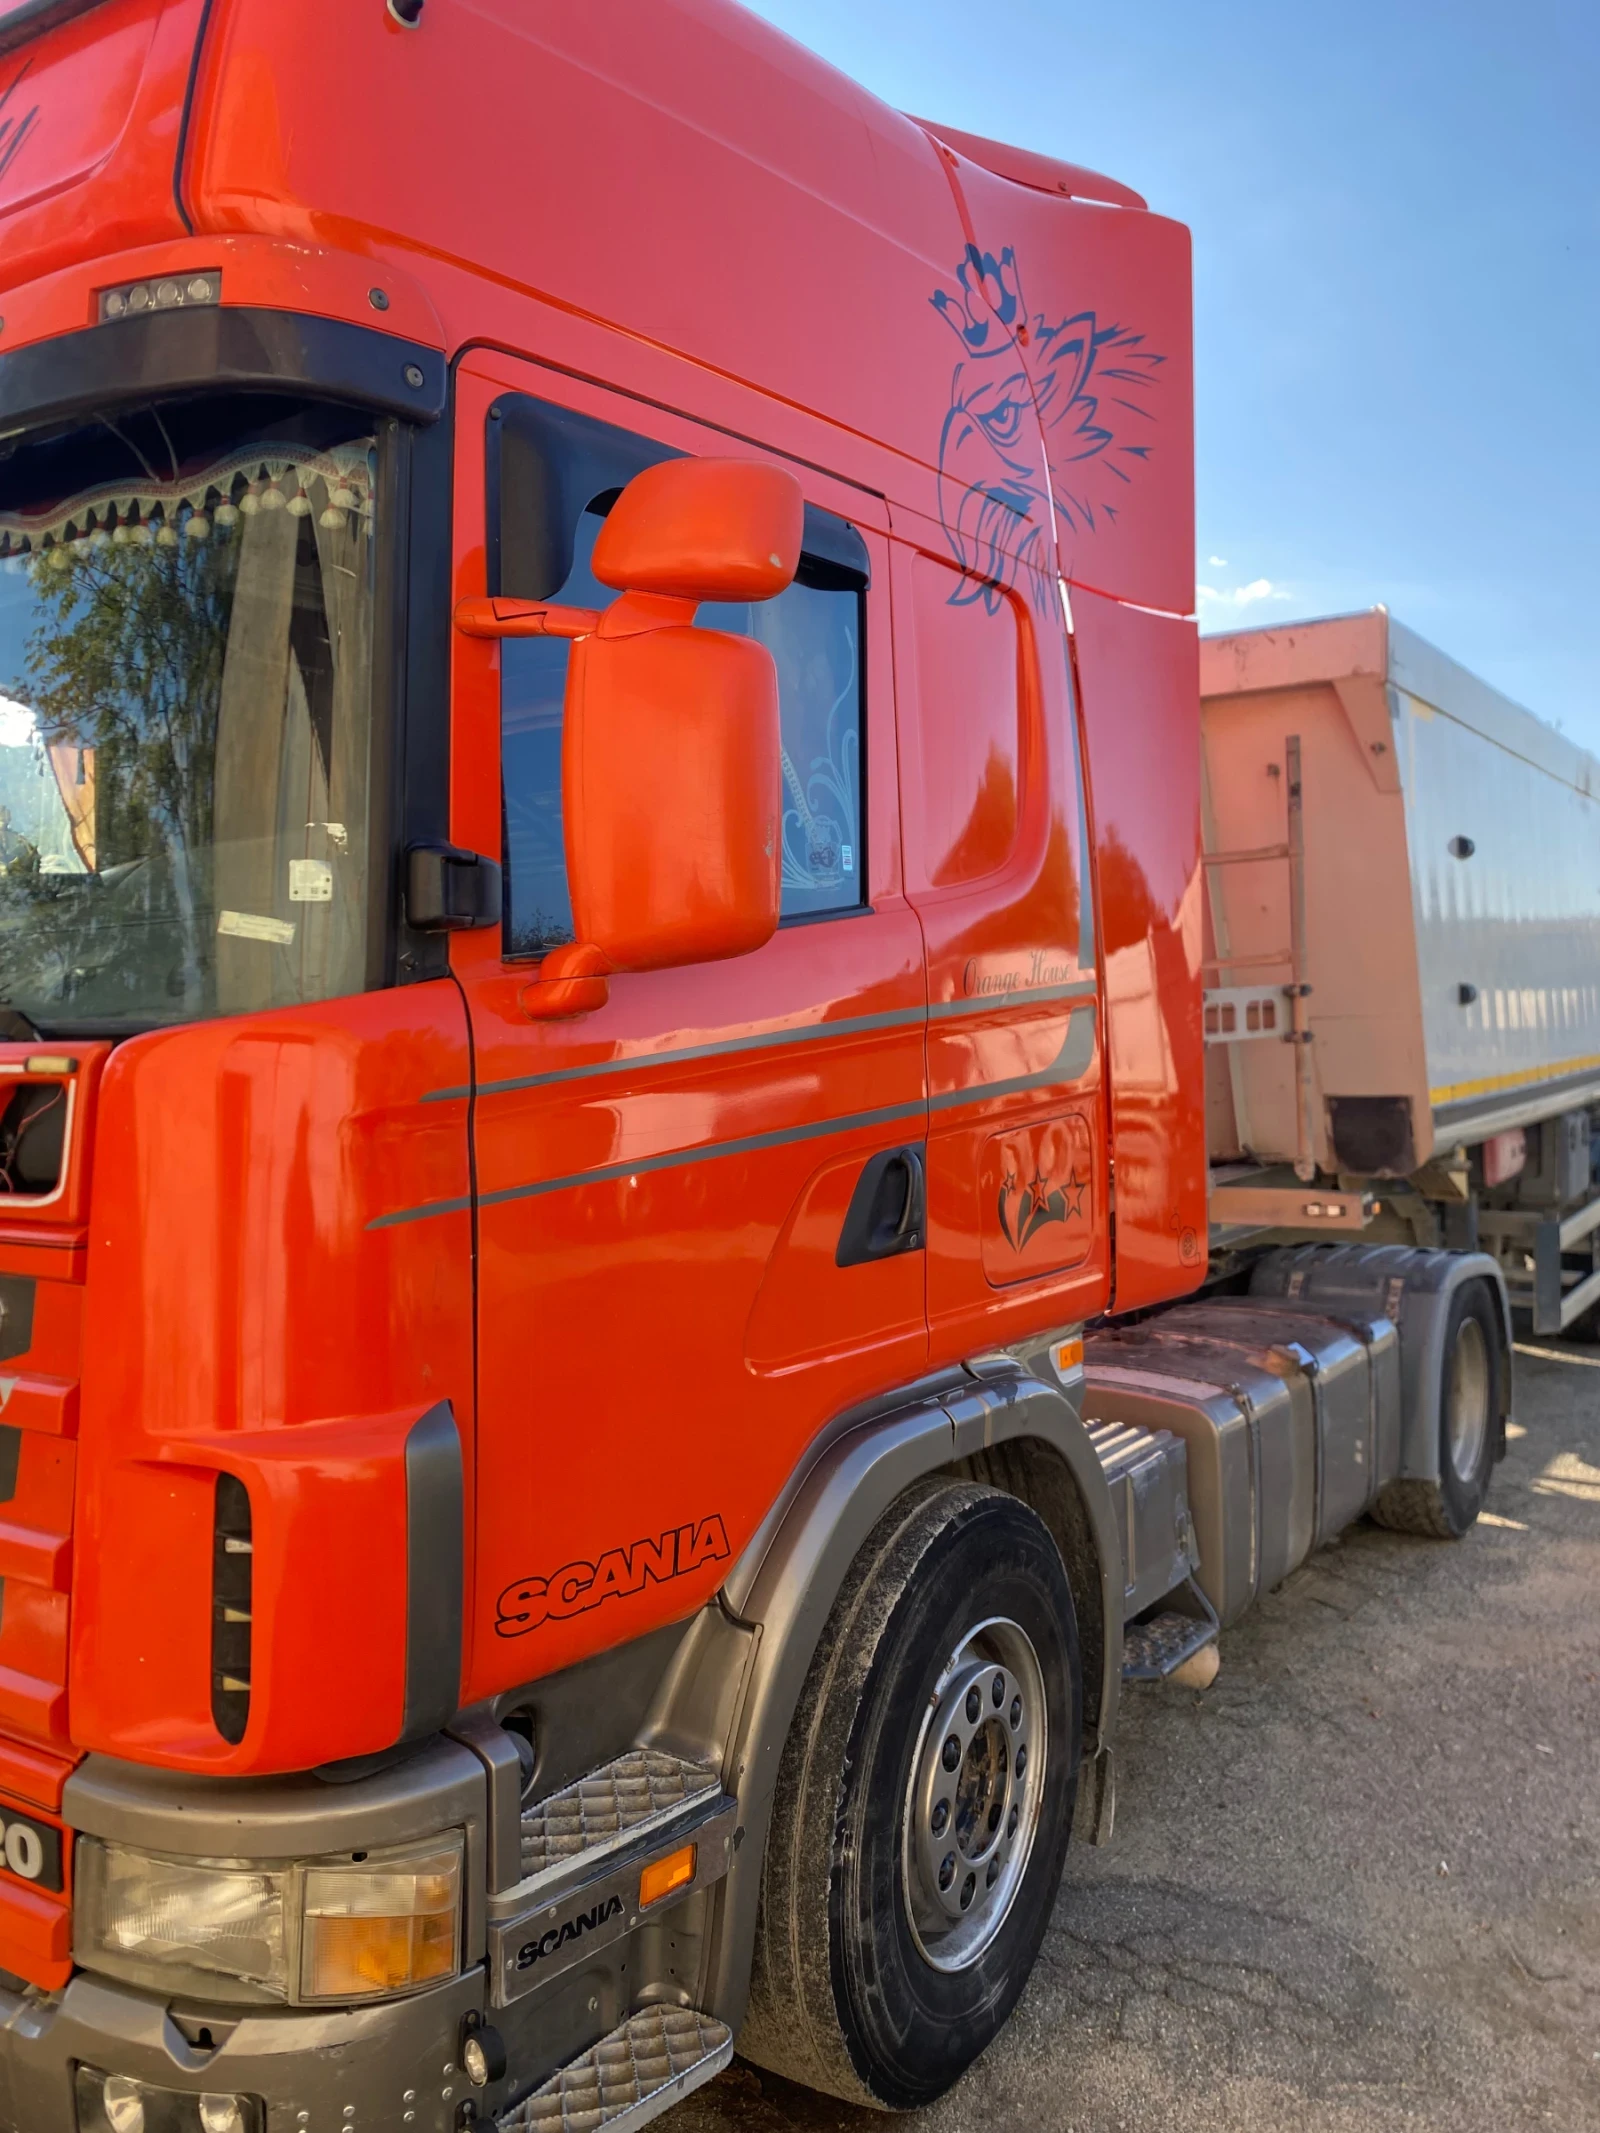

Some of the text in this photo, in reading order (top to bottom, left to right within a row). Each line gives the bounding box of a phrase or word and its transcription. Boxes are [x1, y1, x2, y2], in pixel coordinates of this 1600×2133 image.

[963, 949, 1071, 1004] Orange House
[494, 1513, 732, 1638] SCANIA
[0, 1817, 43, 1879] 0
[517, 1894, 625, 1971] SCANIA
